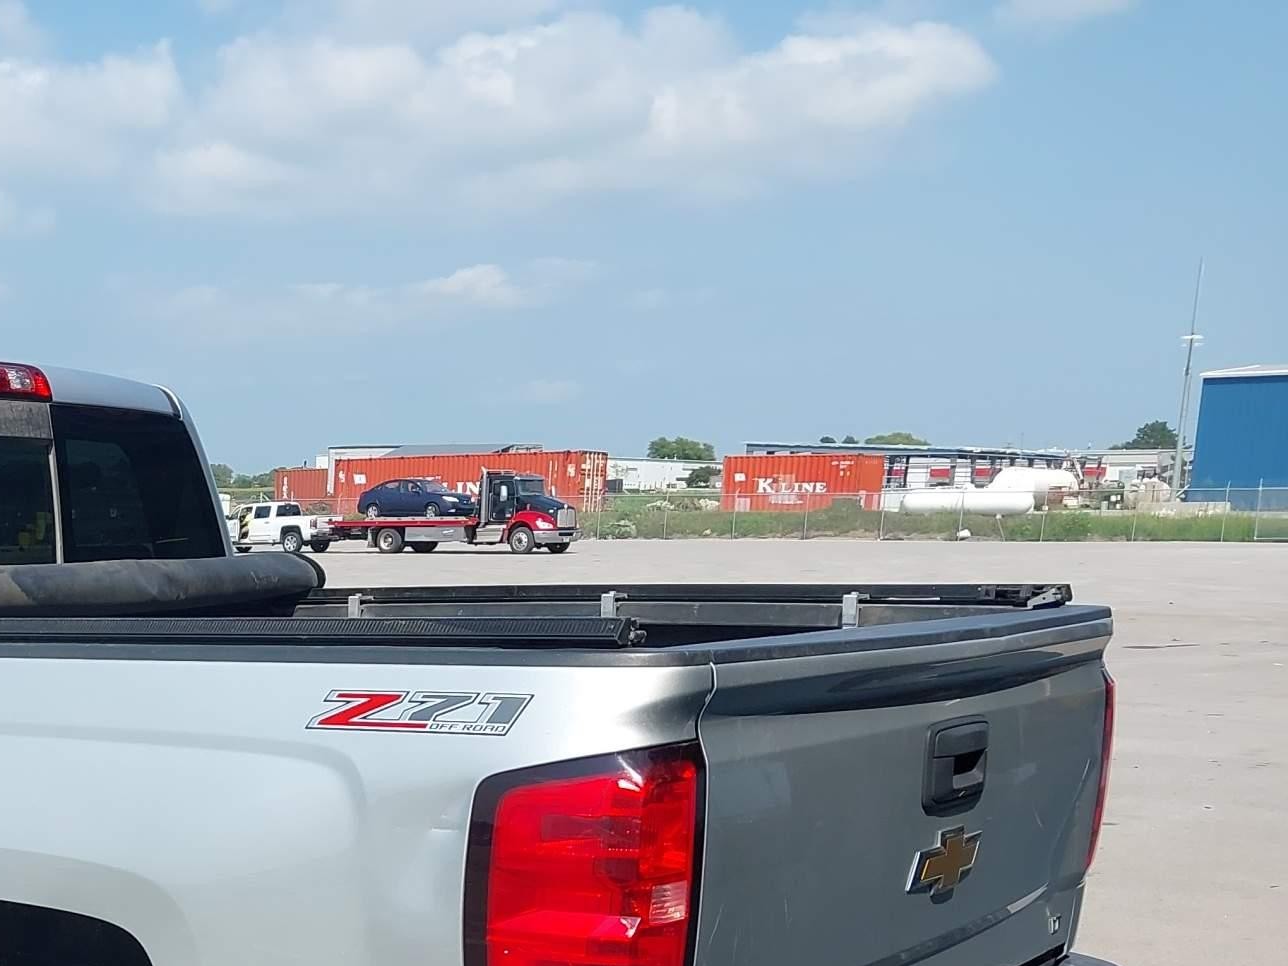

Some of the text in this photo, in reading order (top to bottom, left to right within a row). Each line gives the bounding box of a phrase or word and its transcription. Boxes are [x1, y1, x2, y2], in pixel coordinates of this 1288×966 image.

[781, 481, 827, 493] LINE
[306, 689, 534, 735] Z71
[429, 723, 507, 733] OFF ROAD
